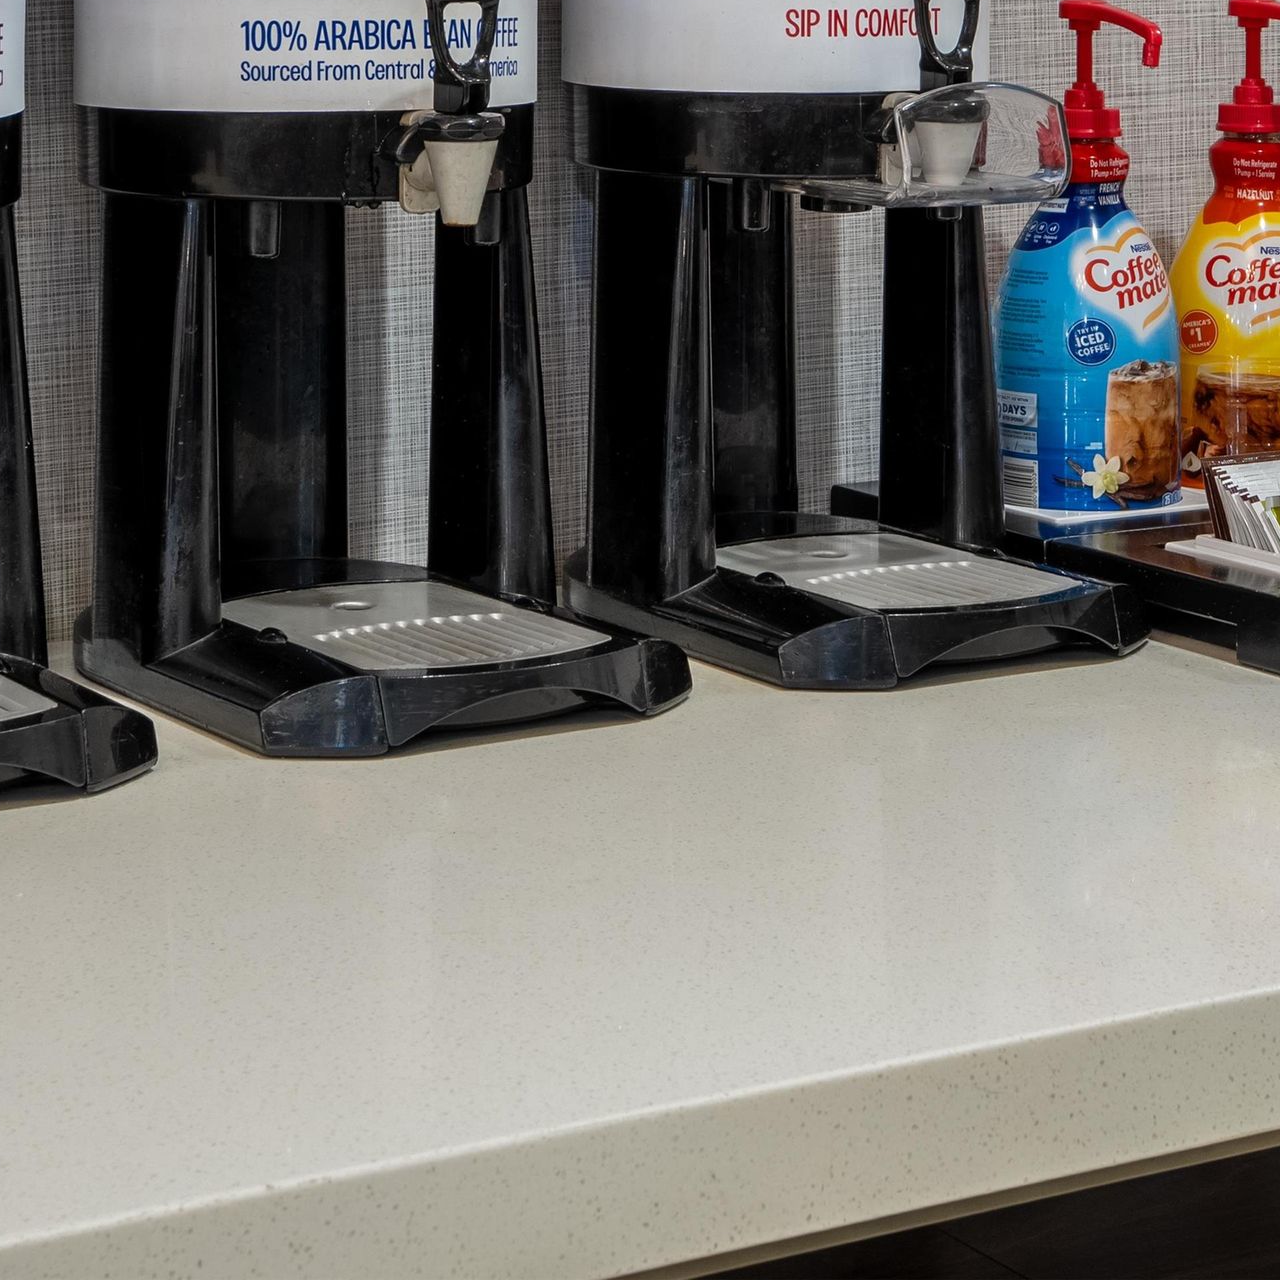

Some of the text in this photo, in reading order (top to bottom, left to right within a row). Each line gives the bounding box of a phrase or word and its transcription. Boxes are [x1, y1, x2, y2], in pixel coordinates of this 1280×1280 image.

[785, 8, 941, 38] SIP IN COMFOT
[240, 17, 518, 52] 100% ARABICA AN FFEE
[240, 60, 312, 82] Sourced
[317, 60, 361, 81] From
[365, 59, 424, 81] Central
[489, 56, 518, 77] merica
[1089, 159, 1098, 168] Do
[1098, 159, 1109, 168] Not
[1232, 157, 1278, 170] Do Not Refrigerate
[1237, 168, 1252, 179] Pump
[1258, 169, 1276, 181] Serving
[1099, 182, 1121, 194] FRENCH
[1236, 187, 1274, 201] HAZELNUT
[1097, 194, 1121, 206] VANILLA
[1084, 252, 1161, 293] Coffee
[1116, 272, 1167, 310] mate
[1076, 327, 1089, 335] TRY
[1075, 331, 1105, 348] ICED
[1077, 342, 1111, 357] COFFEE
[1002, 402, 1027, 416] DAYS
